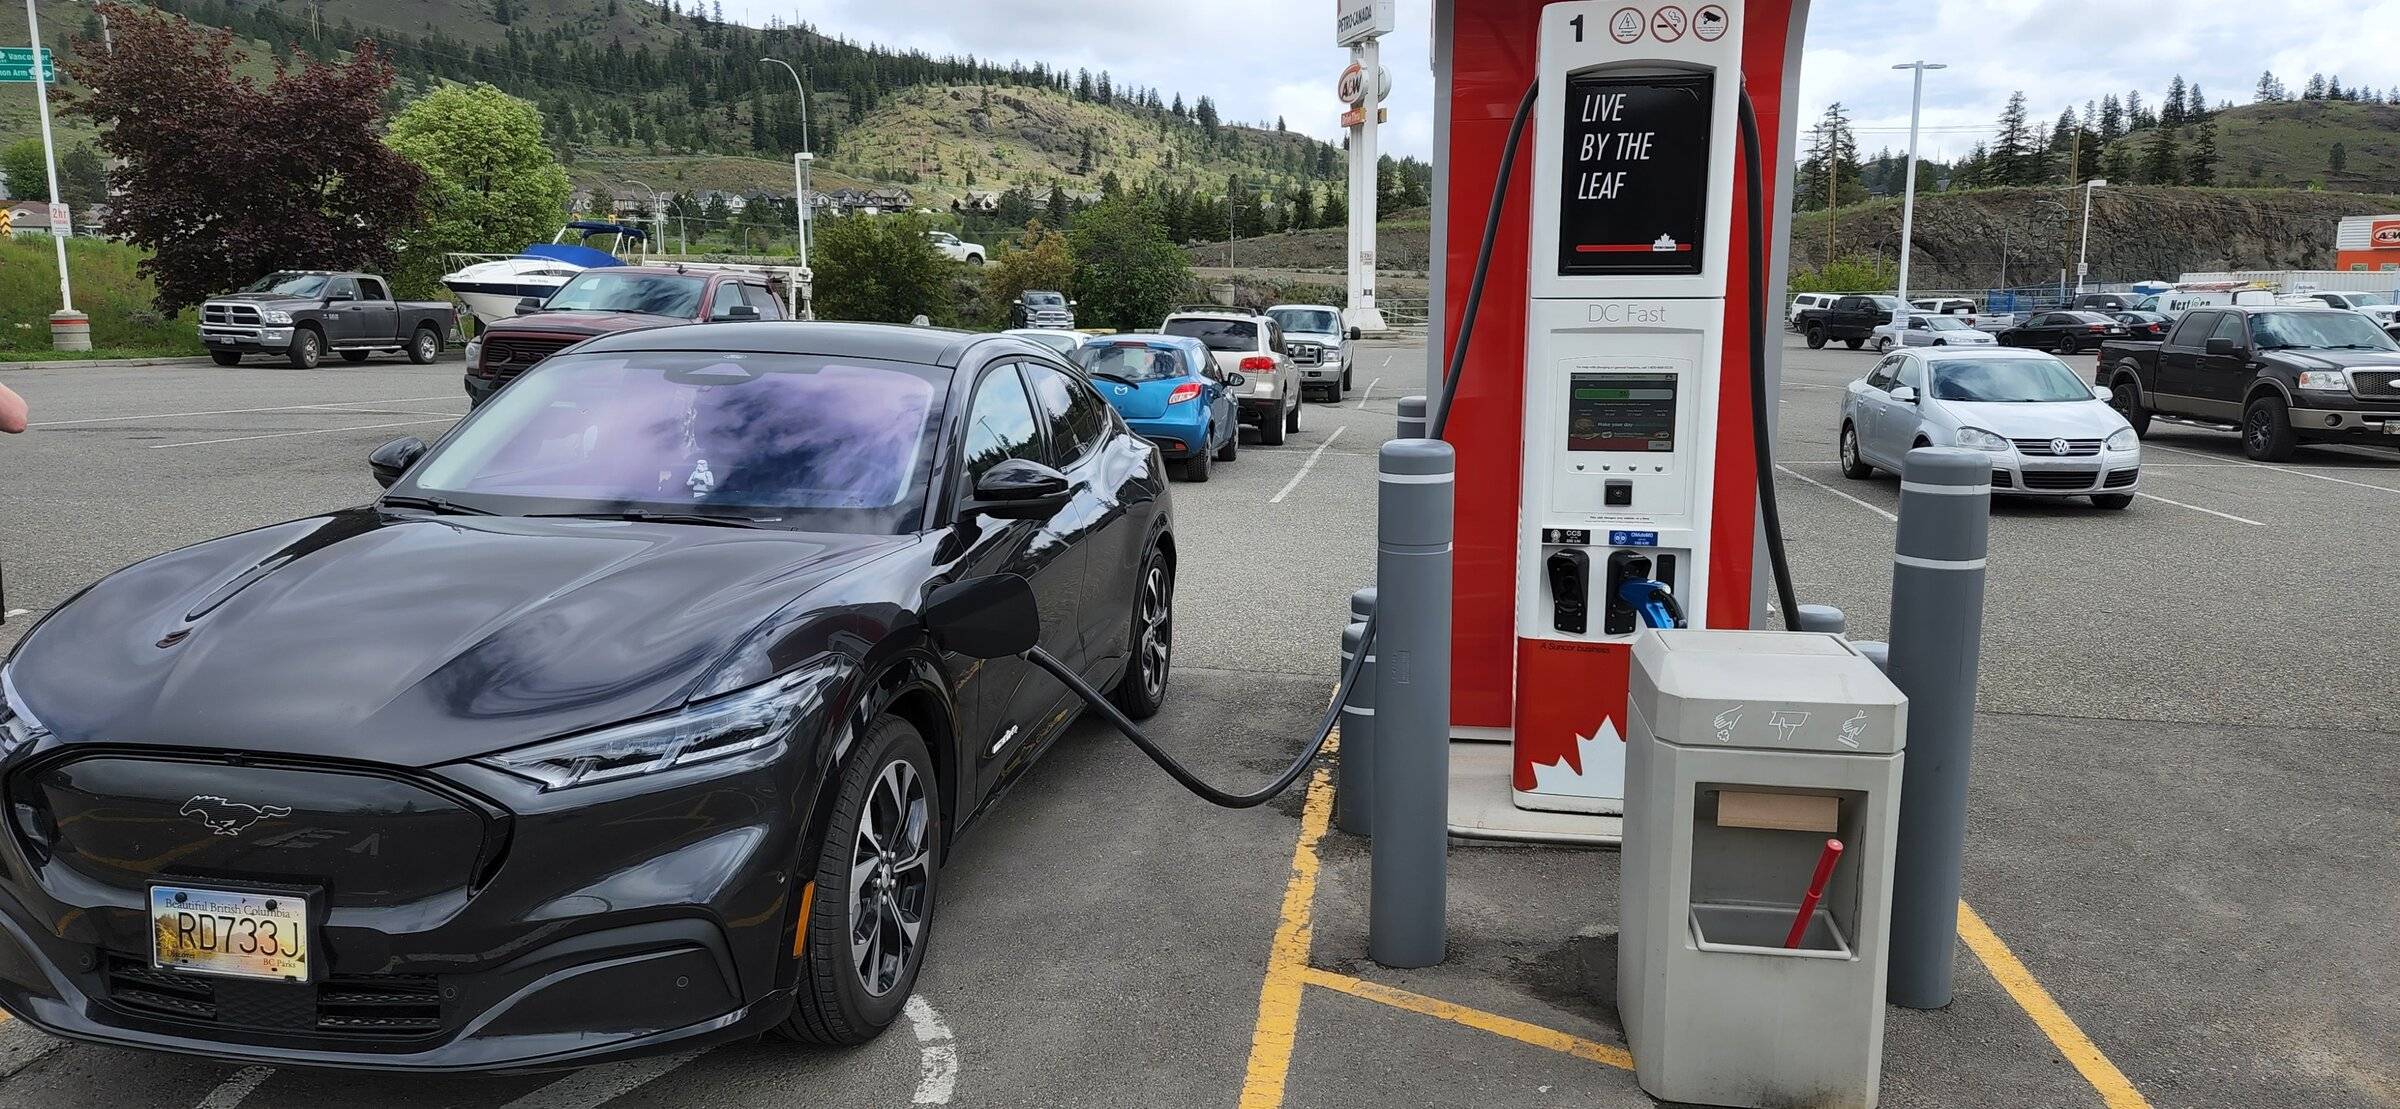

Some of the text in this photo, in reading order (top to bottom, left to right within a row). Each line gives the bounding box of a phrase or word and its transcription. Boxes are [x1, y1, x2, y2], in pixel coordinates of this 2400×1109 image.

[1570, 14, 1583, 42] 1
[8, 53, 49, 61] Vancoer
[13, 69, 28, 77] Arm
[1341, 72, 1362, 99] A&W
[1582, 94, 1627, 122] LIVE
[1580, 132, 1655, 161] BY THE
[1578, 172, 1627, 200] LEAF
[1588, 304, 1666, 322] DC Fast
[165, 898, 291, 919] Beautiful British Columbia
[178, 912, 298, 957] RD733J
[263, 958, 274, 966] BC
[277, 959, 296, 967] Parks
